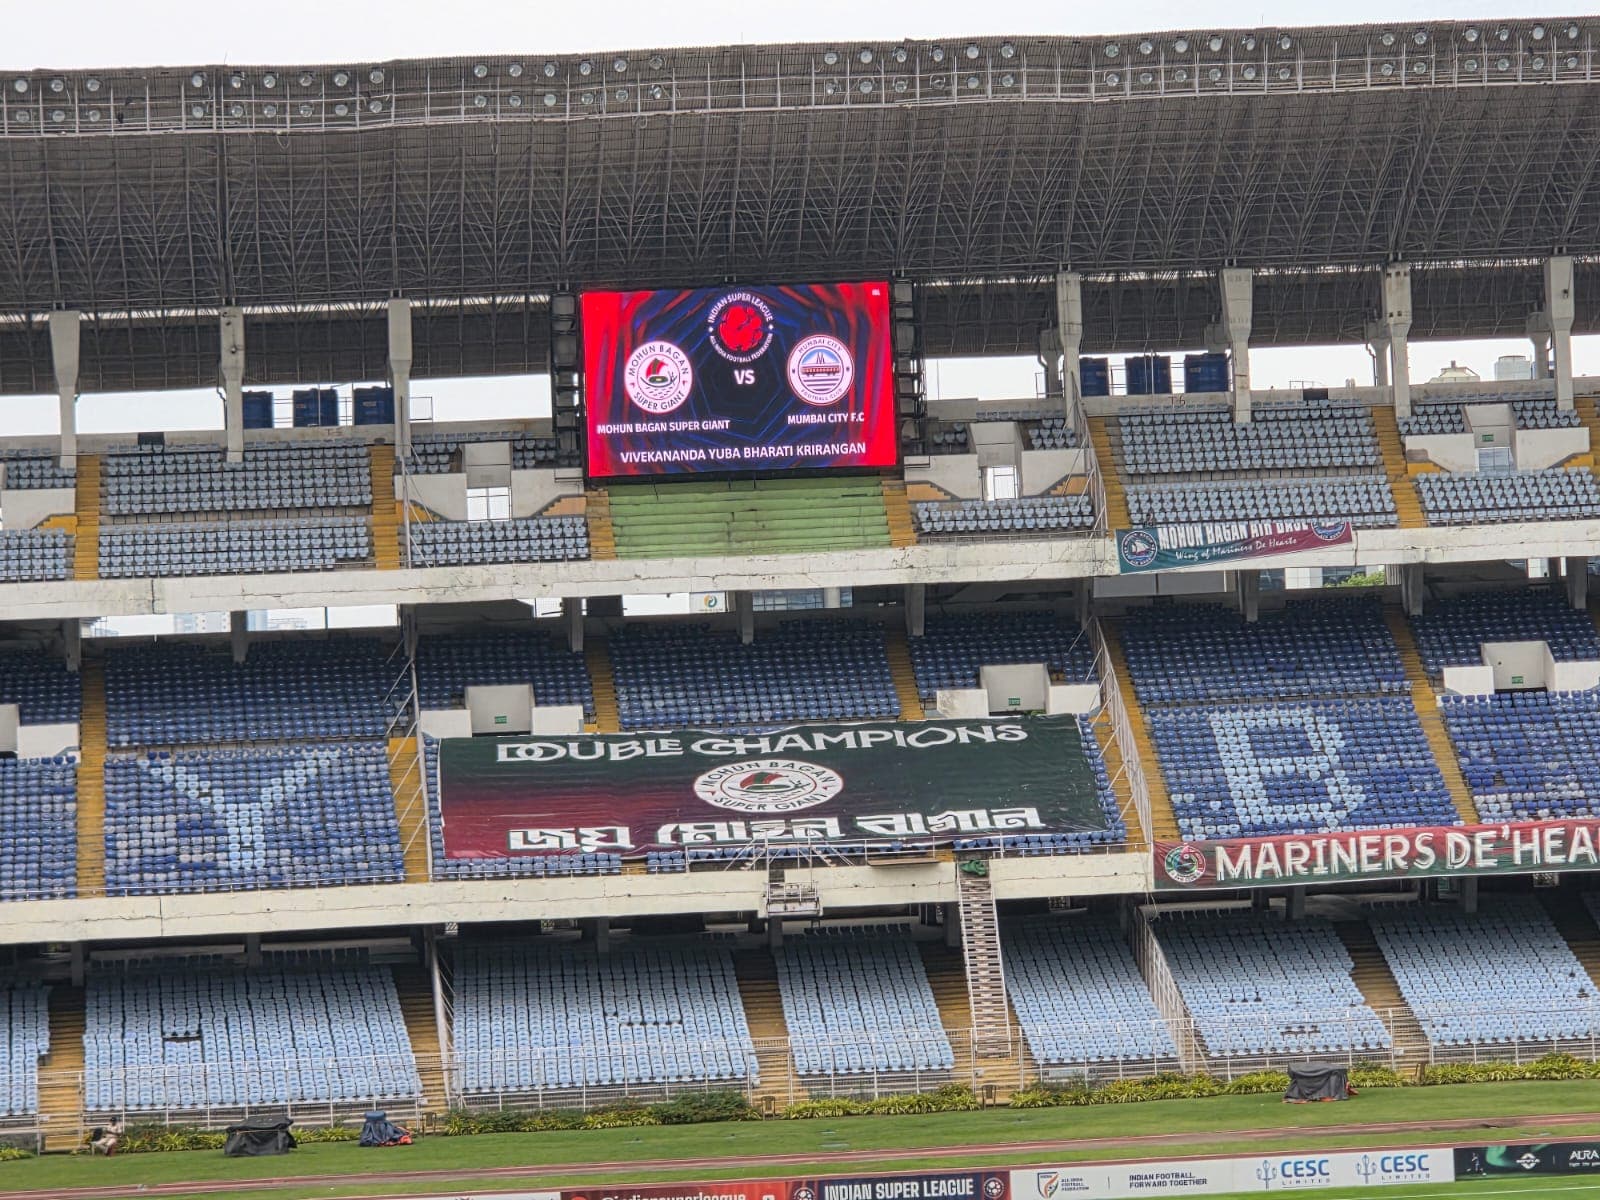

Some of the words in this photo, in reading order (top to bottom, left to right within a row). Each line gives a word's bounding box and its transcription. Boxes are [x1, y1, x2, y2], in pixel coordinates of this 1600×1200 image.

[708, 297, 728, 323] INDIAN
[727, 292, 751, 303] SUPER
[751, 296, 774, 322] LEAGUE
[628, 345, 656, 377] MOHUN
[659, 344, 689, 375] BAGAN
[733, 369, 756, 385] VS
[633, 391, 658, 410] SUPER
[660, 390, 685, 410] GIANT
[597, 423, 633, 434] MOHUN
[635, 422, 667, 433] BAGAN
[669, 420, 700, 431] SUPER
[701, 419, 731, 430] GIANT
[787, 413, 826, 425] MUMBAI
[827, 412, 849, 423] CITY
[620, 449, 707, 464] VIVEKANANDA
[708, 447, 741, 460] YUBA
[743, 445, 794, 459] BHARATI
[796, 442, 867, 456] KRIRANGAN
[1157, 525, 1203, 550] MOHUN
[1205, 522, 1249, 544] BAGAN
[1175, 551, 1199, 562] Wing
[1201, 548, 1210, 560] of
[497, 737, 683, 763] DOUBLE
[690, 723, 1028, 757] CHAMPIONS
[701, 761, 761, 788] MOHUN
[768, 761, 836, 784] BAGAN
[713, 797, 767, 811] SUPER
[773, 792, 829, 811] GIANT
[508, 826, 636, 854] জয়
[856, 807, 1047, 836] বাগান
[1215, 832, 1437, 882] MARINERS
[1446, 824, 1600, 871] DE'HEA
[1280, 1159, 1331, 1179] CESC
[1380, 1154, 1430, 1174] CESC
[1129, 1173, 1155, 1182] INDIAN
[1129, 1180, 1168, 1189] FORWARD
[1169, 1178, 1208, 1187] TOGETHER
[824, 1184, 872, 1200] INDIAN
[876, 1181, 919, 1199] SUPER
[923, 1178, 974, 1198] LEAGUE
